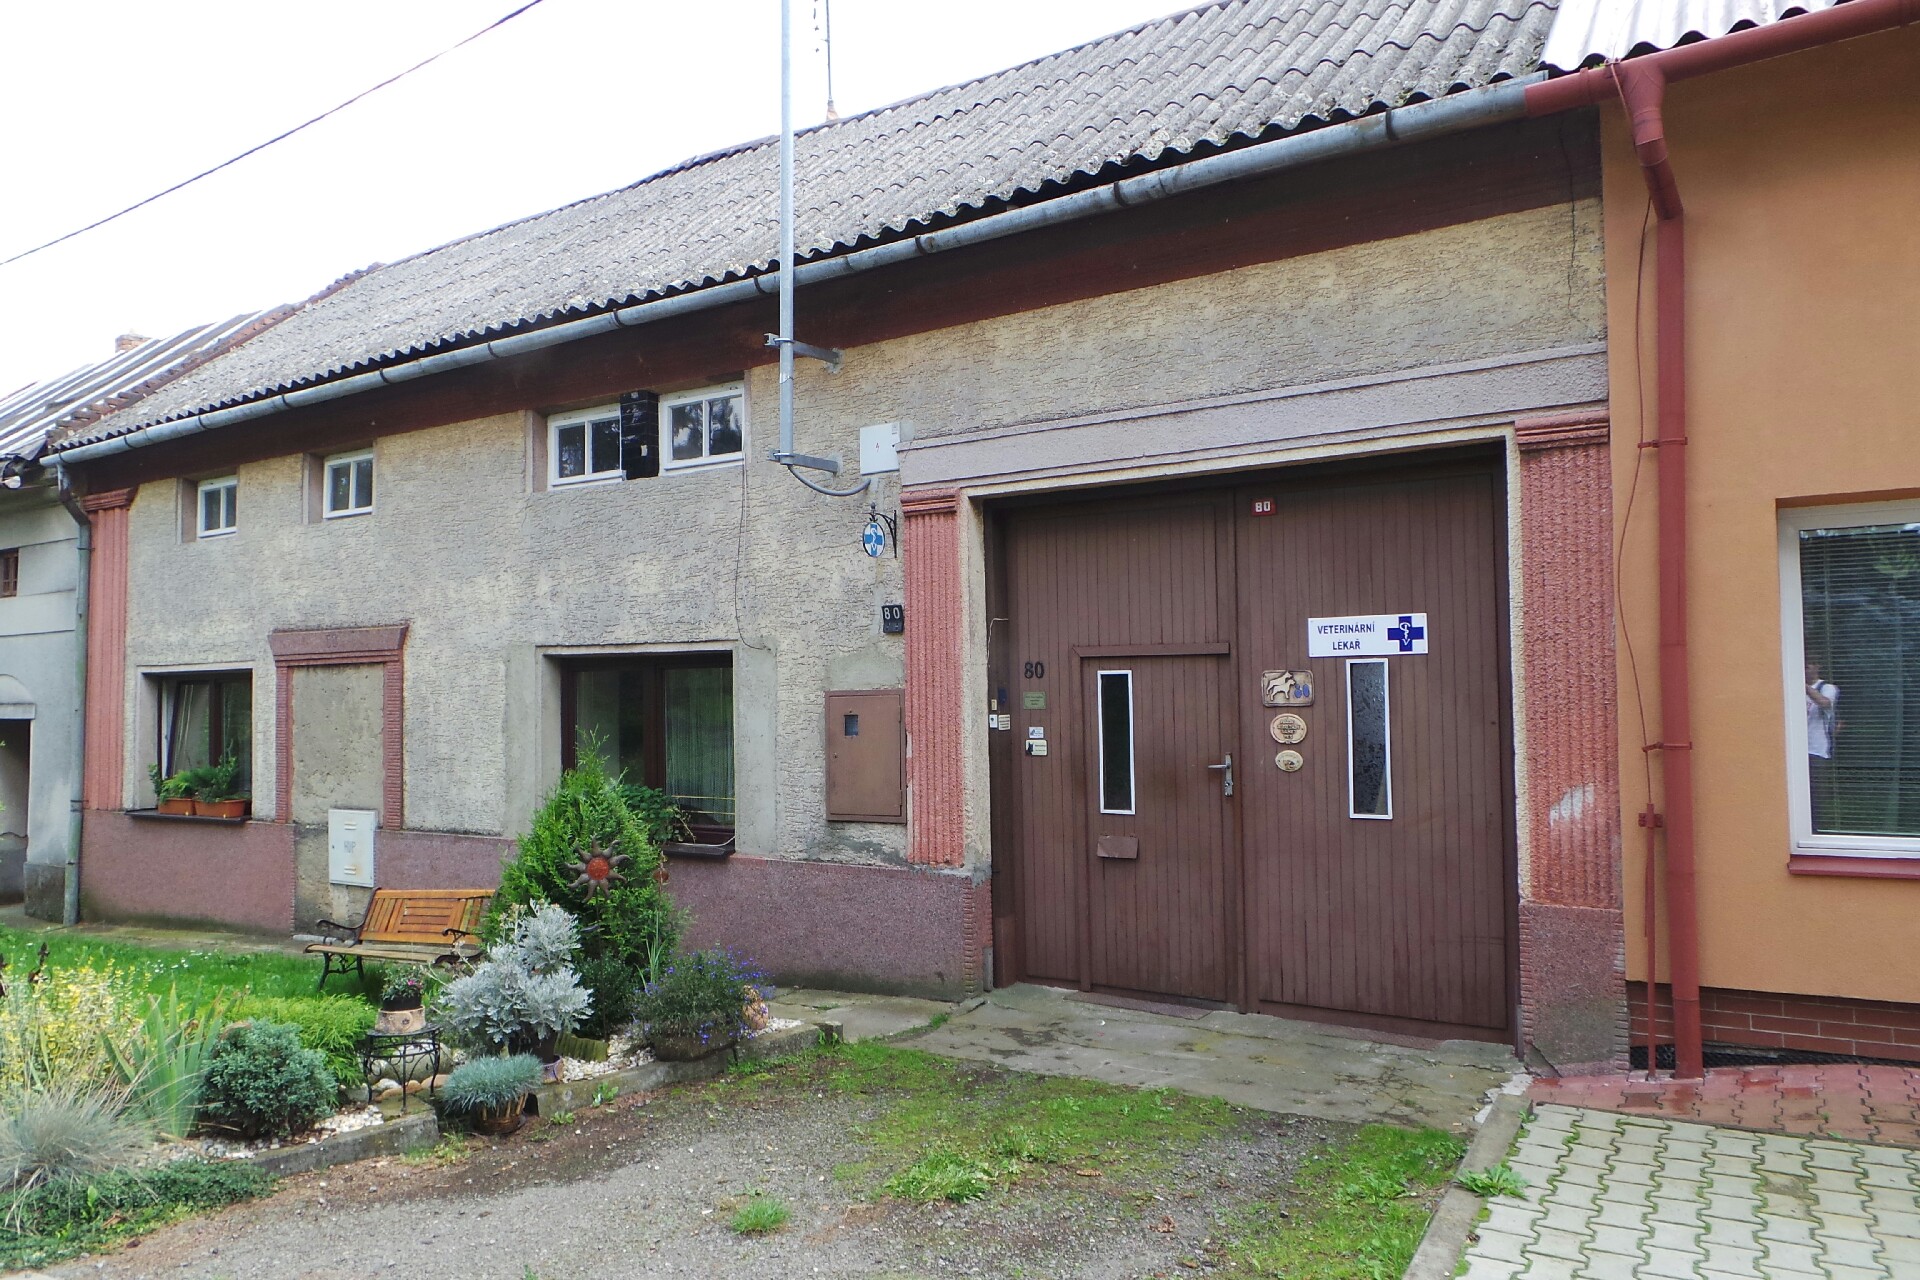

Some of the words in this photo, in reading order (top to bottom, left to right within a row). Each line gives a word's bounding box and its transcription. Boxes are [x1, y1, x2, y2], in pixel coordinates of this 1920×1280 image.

[1255, 501, 1271, 513] 80
[884, 607, 900, 619] 80
[1317, 620, 1375, 634] VETERINÁRNÍ
[1332, 638, 1360, 650] LÉKAŘ
[1024, 661, 1045, 678] 80
